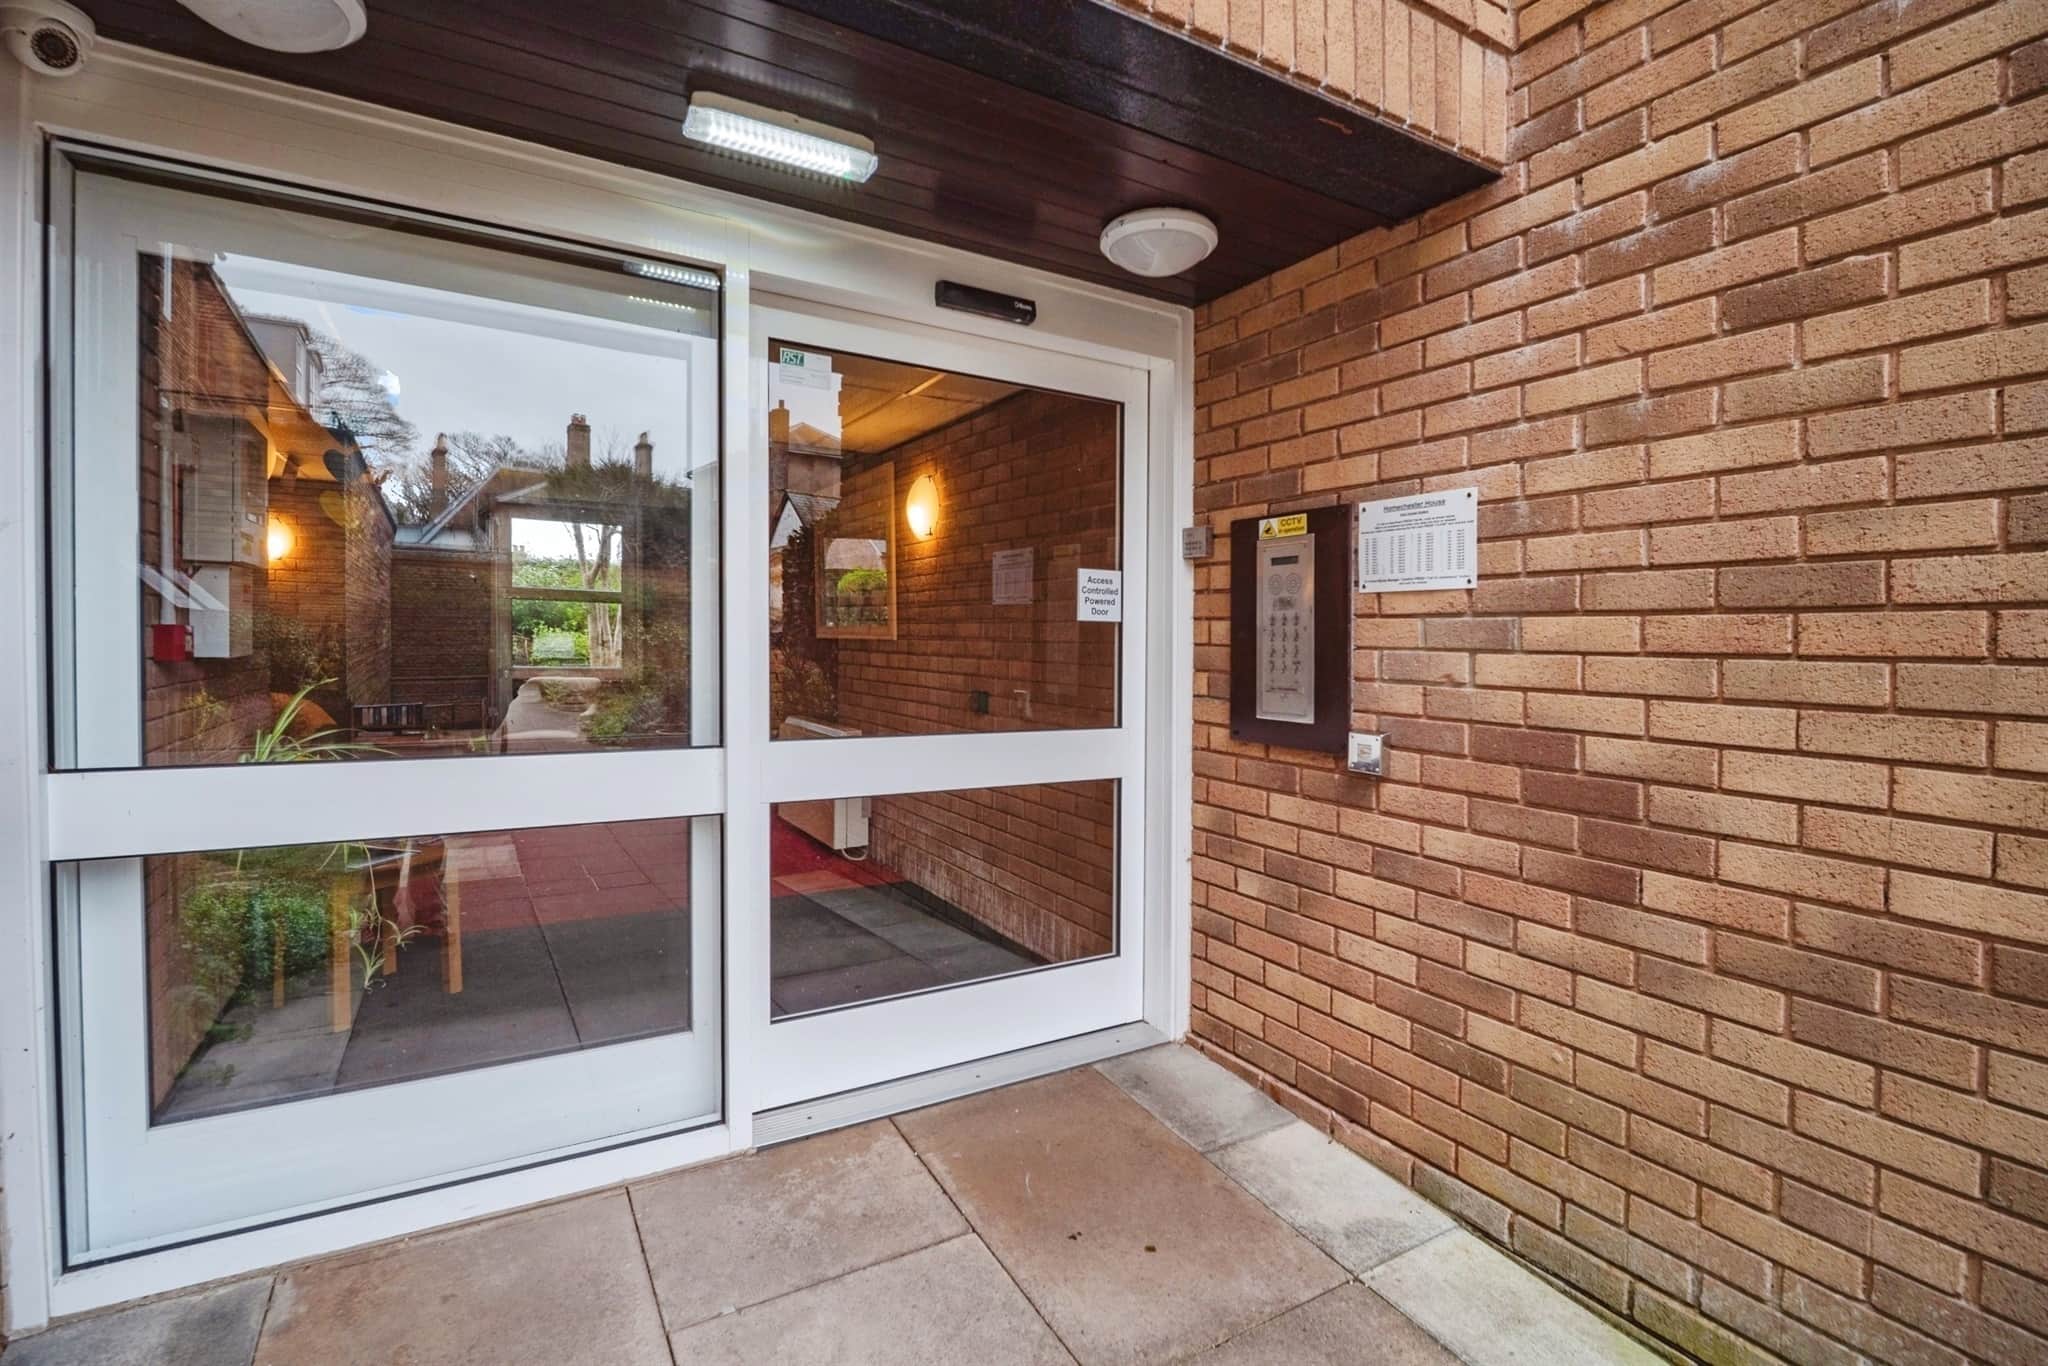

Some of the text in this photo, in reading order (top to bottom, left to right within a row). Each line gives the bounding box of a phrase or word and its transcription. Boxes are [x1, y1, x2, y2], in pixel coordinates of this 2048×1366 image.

[1280, 516, 1304, 527] CCTV
[1087, 576, 1113, 585] Access
[1081, 586, 1119, 596] Controlled
[1084, 596, 1116, 606] Powered
[1091, 607, 1109, 616] Door
